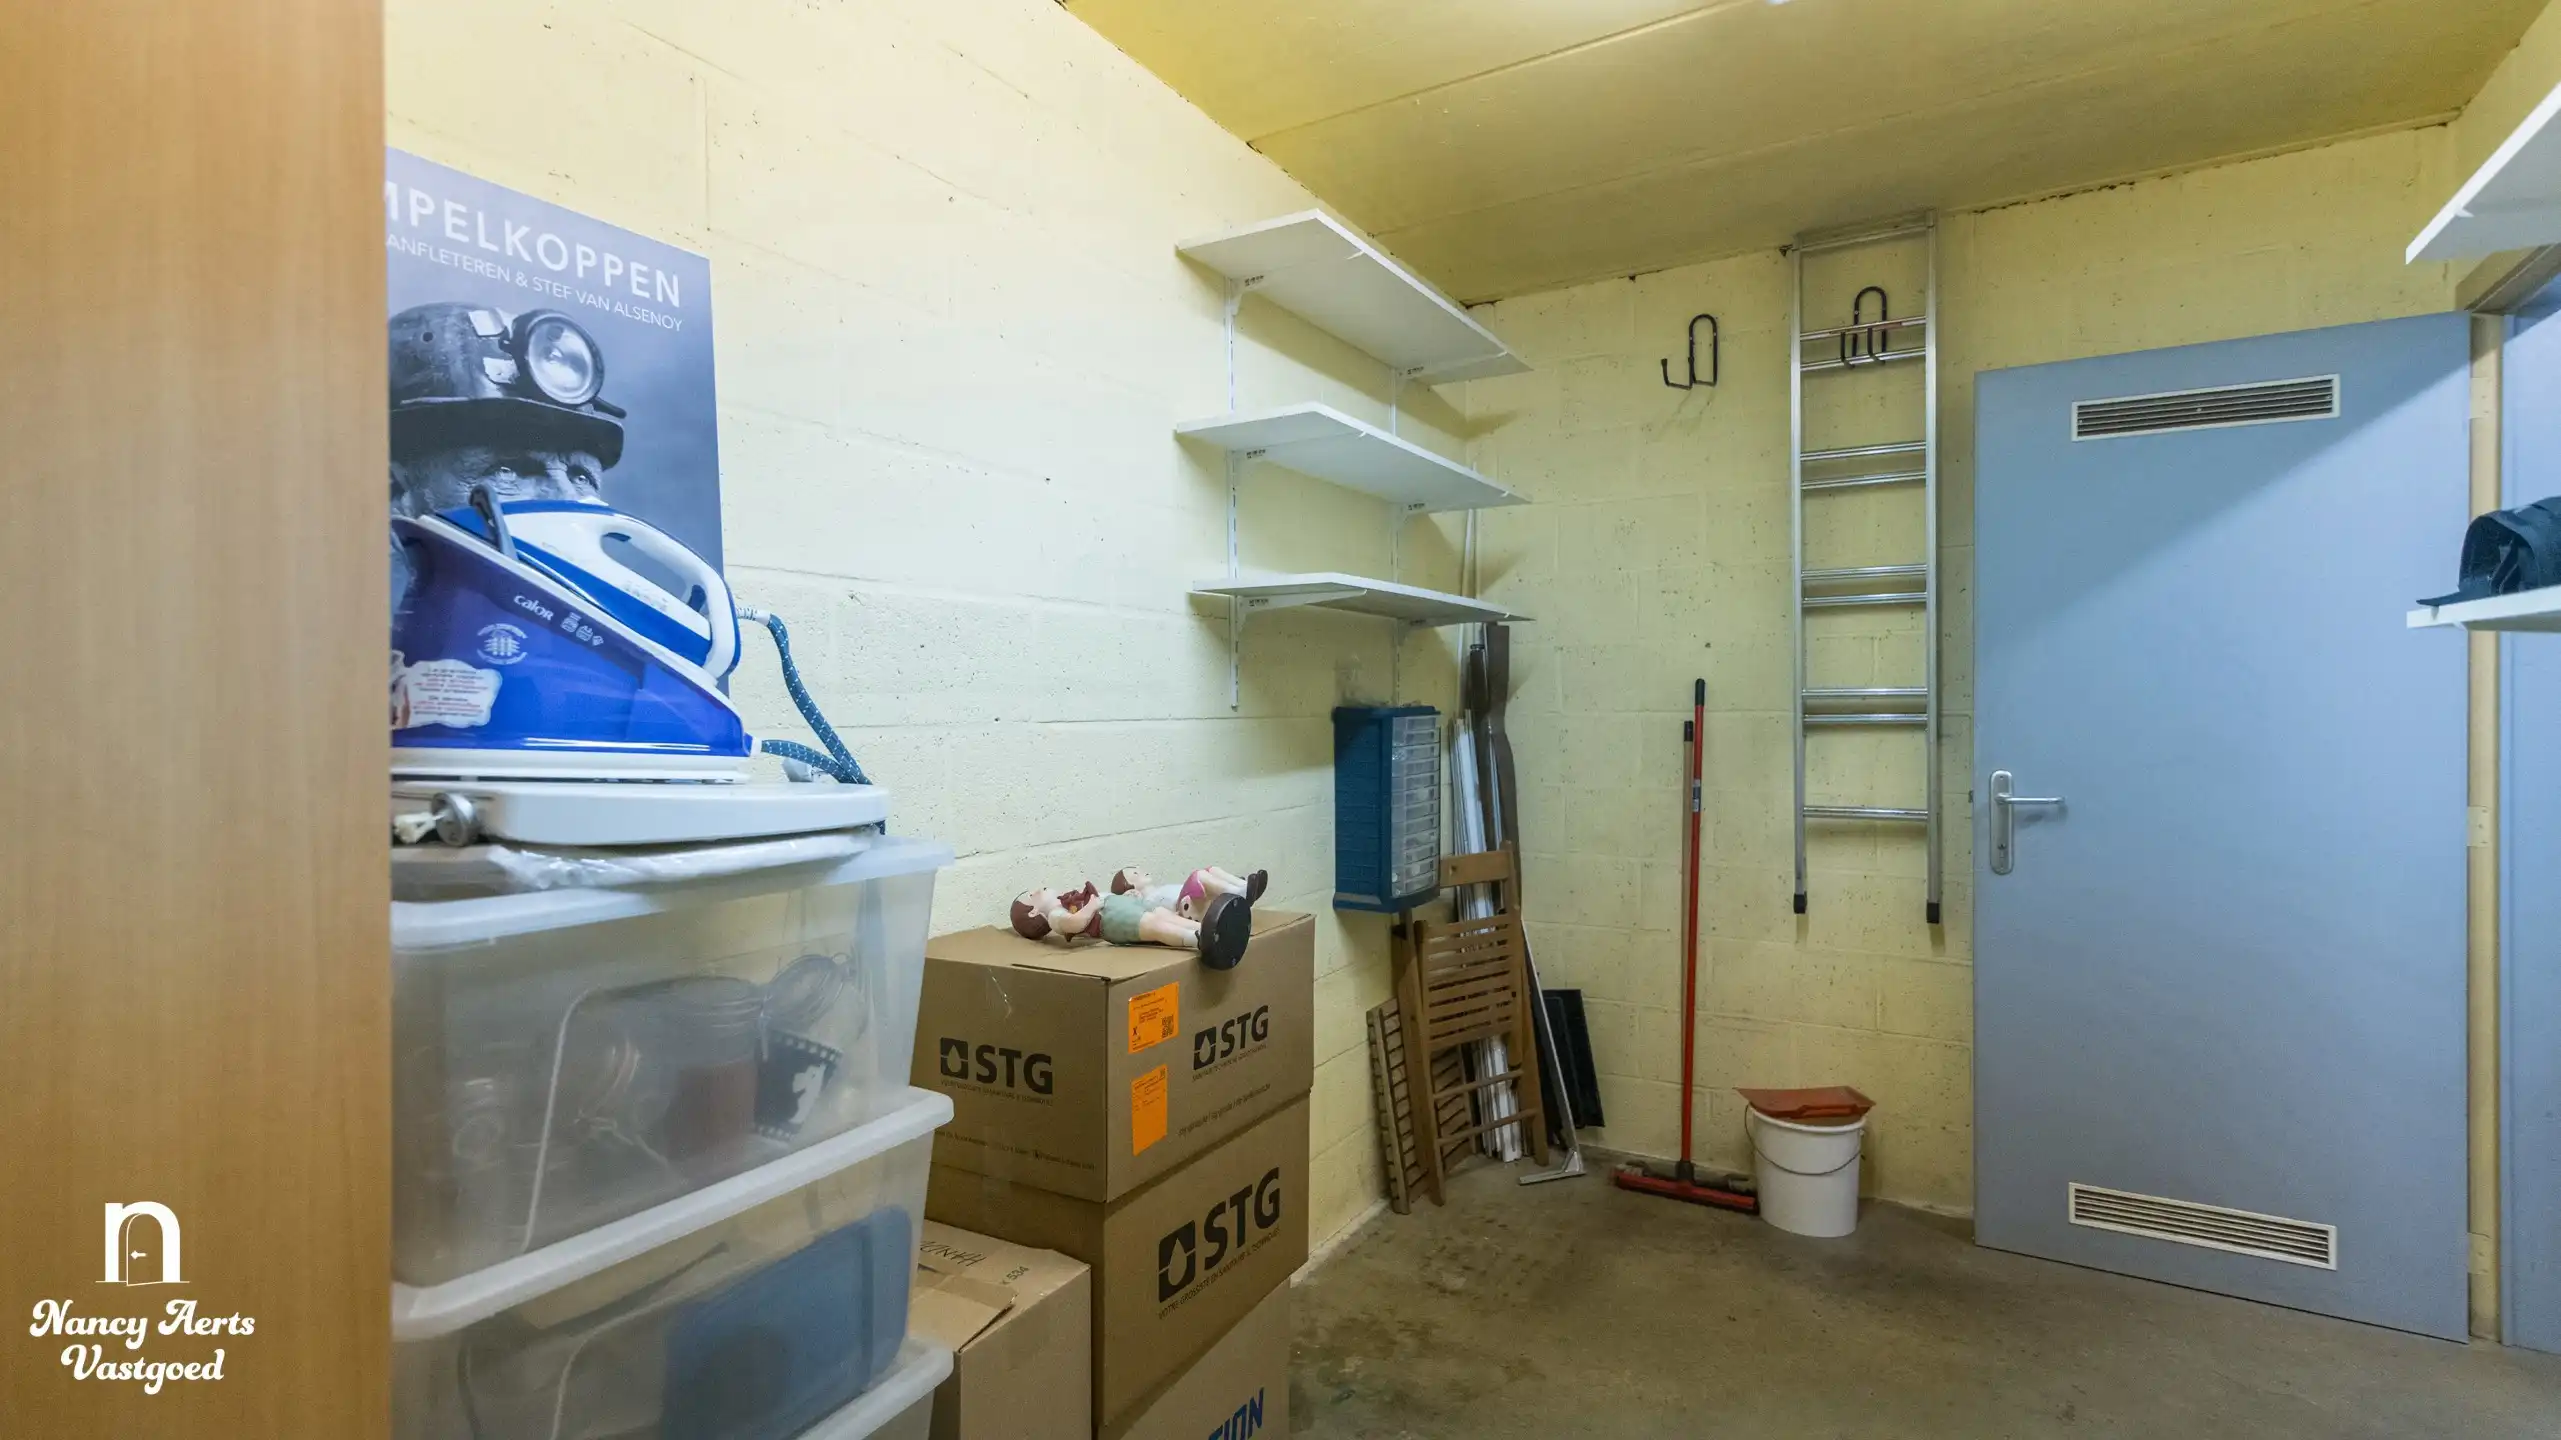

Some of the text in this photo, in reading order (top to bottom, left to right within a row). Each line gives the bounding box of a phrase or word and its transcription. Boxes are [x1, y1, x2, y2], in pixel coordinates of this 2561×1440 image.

[516, 271, 528, 288] &
[533, 277, 573, 300] STEF
[575, 289, 610, 312] VAN
[613, 300, 683, 332] ALSENOY
[1220, 1005, 1269, 1058] STG
[975, 1044, 1053, 1095] STG
[1203, 1167, 1280, 1271] STG
